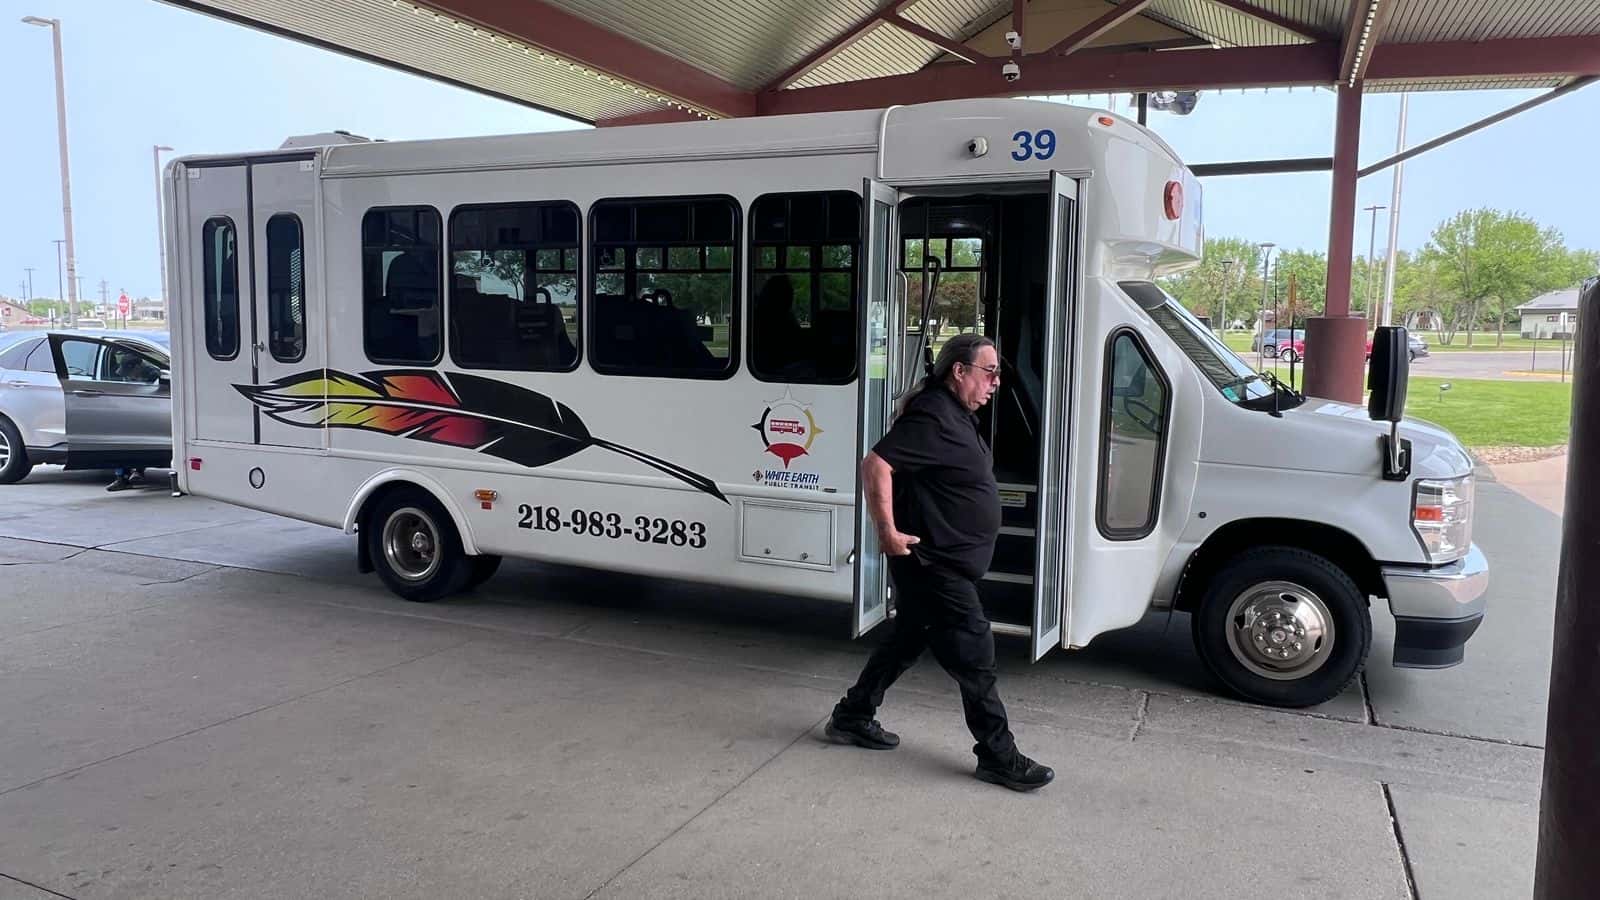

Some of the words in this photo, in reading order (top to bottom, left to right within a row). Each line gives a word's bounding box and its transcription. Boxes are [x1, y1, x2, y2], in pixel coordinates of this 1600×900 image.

[1011, 129, 1056, 161] 39
[764, 480, 788, 488] PUBLIC
[790, 483, 819, 491] TRANSIT
[765, 470, 790, 481] WHITE
[791, 472, 819, 484] EARTH
[518, 504, 707, 548] 218-983-3283
